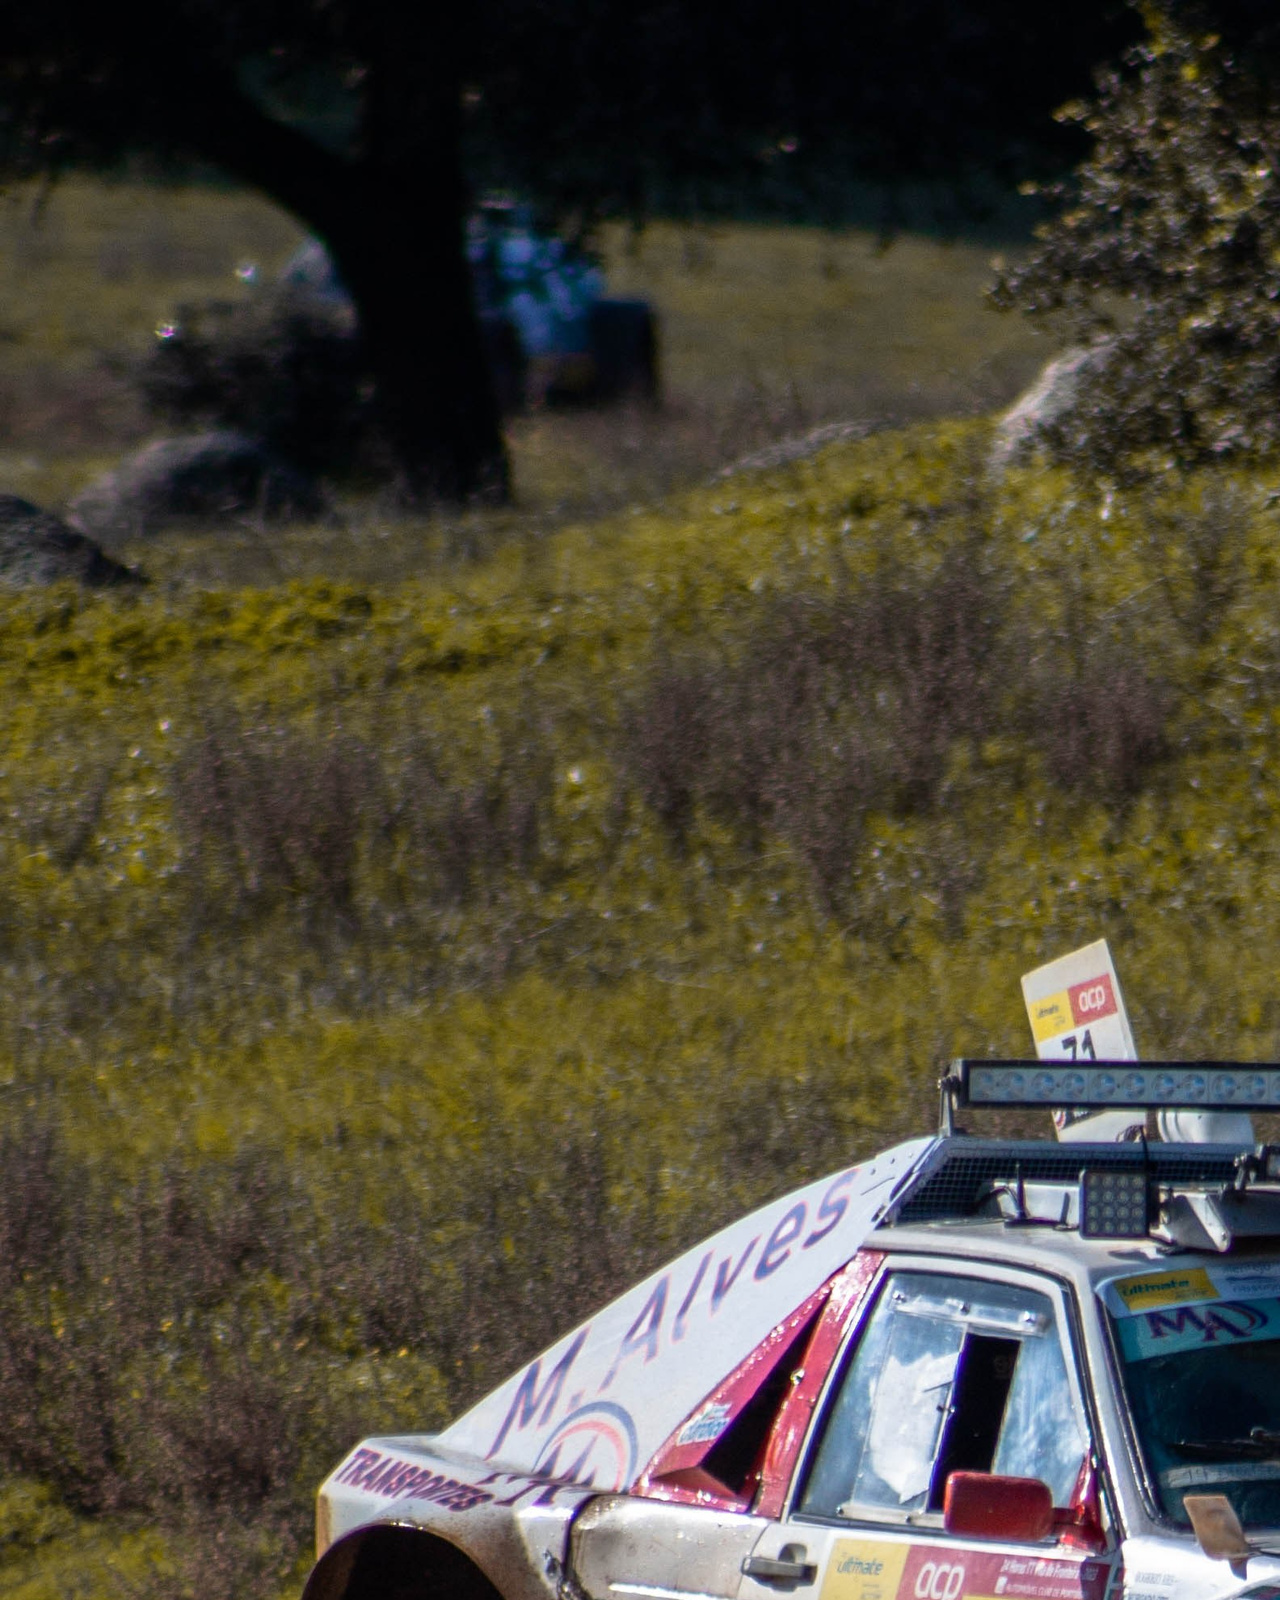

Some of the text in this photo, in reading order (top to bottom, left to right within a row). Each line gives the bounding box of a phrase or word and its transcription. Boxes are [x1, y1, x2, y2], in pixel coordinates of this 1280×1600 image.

[1078, 984, 1106, 1013] acp
[1061, 1028, 1097, 1060] 71
[335, 1447, 495, 1513] TRANSPORTES
